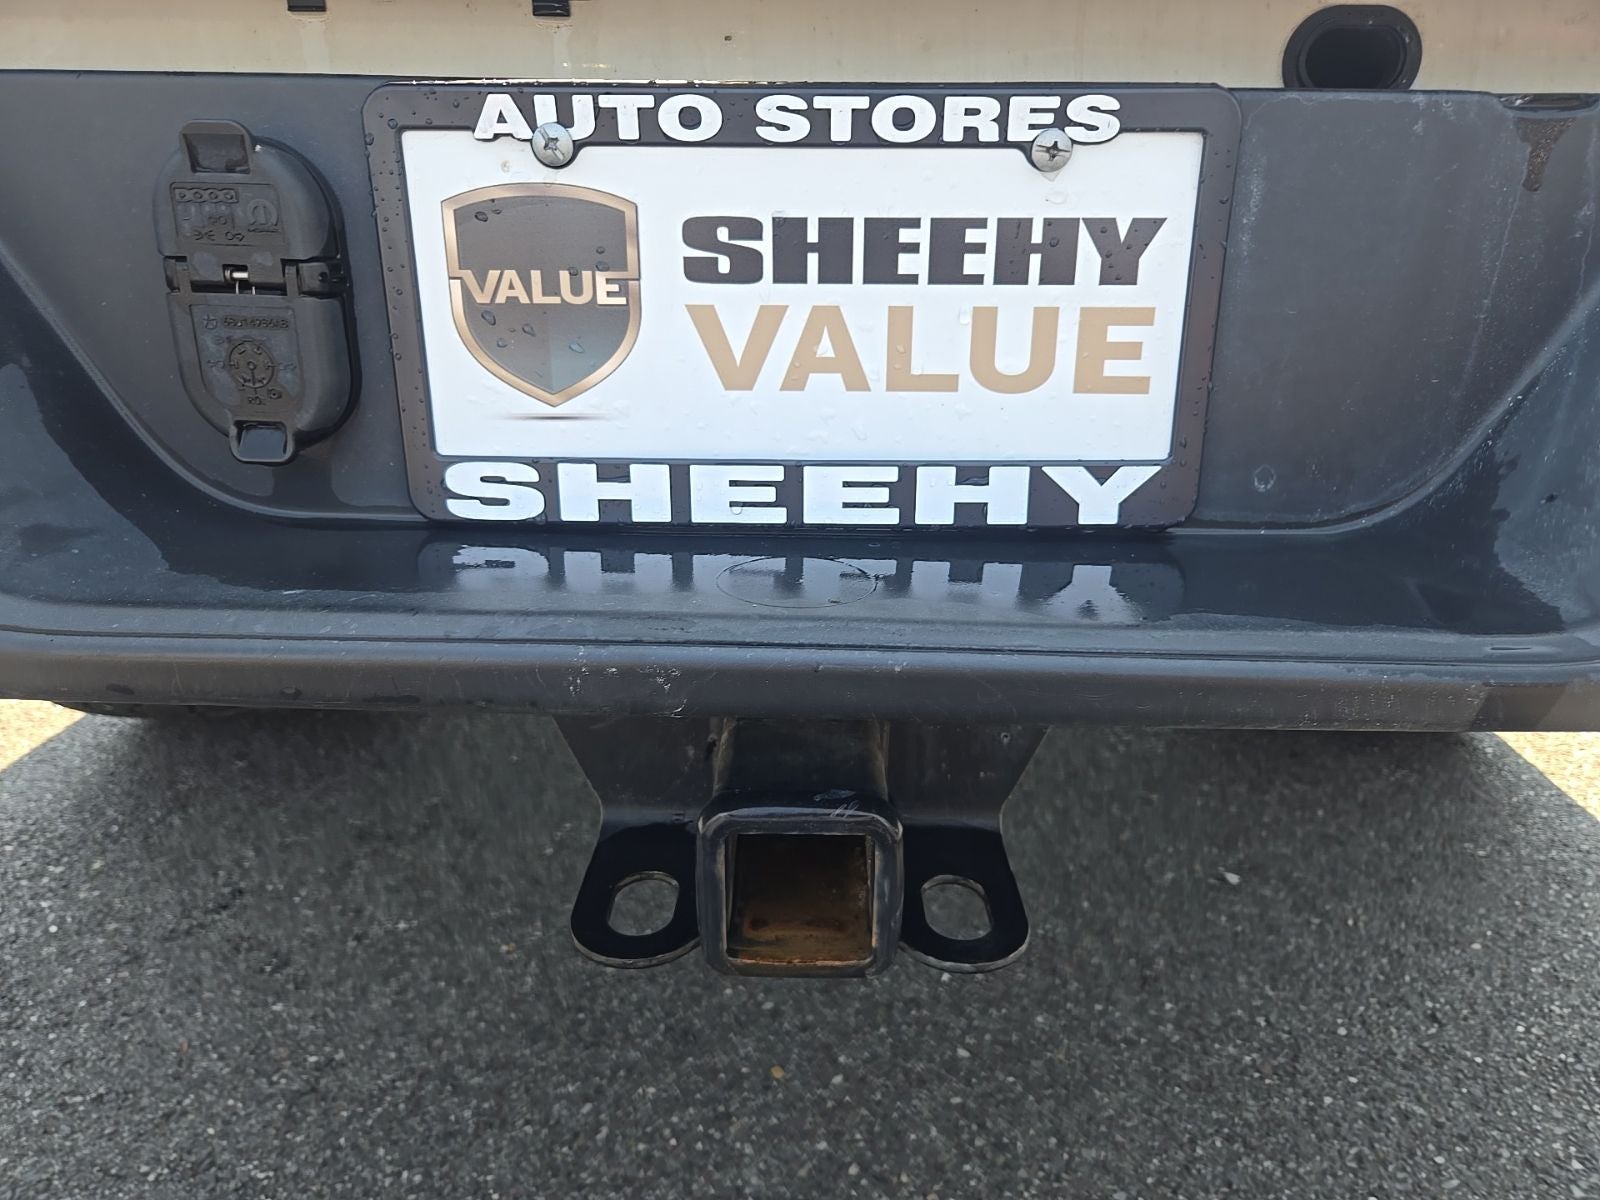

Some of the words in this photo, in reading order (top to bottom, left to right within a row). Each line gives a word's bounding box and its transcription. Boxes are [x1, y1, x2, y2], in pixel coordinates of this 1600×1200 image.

[474, 93, 724, 142] AUTO
[754, 94, 1122, 144] STORES
[682, 215, 1168, 286] SHEEHY
[461, 269, 628, 306] VALUE
[685, 304, 1157, 395] VALUE
[445, 461, 1163, 525] SHEEHY
